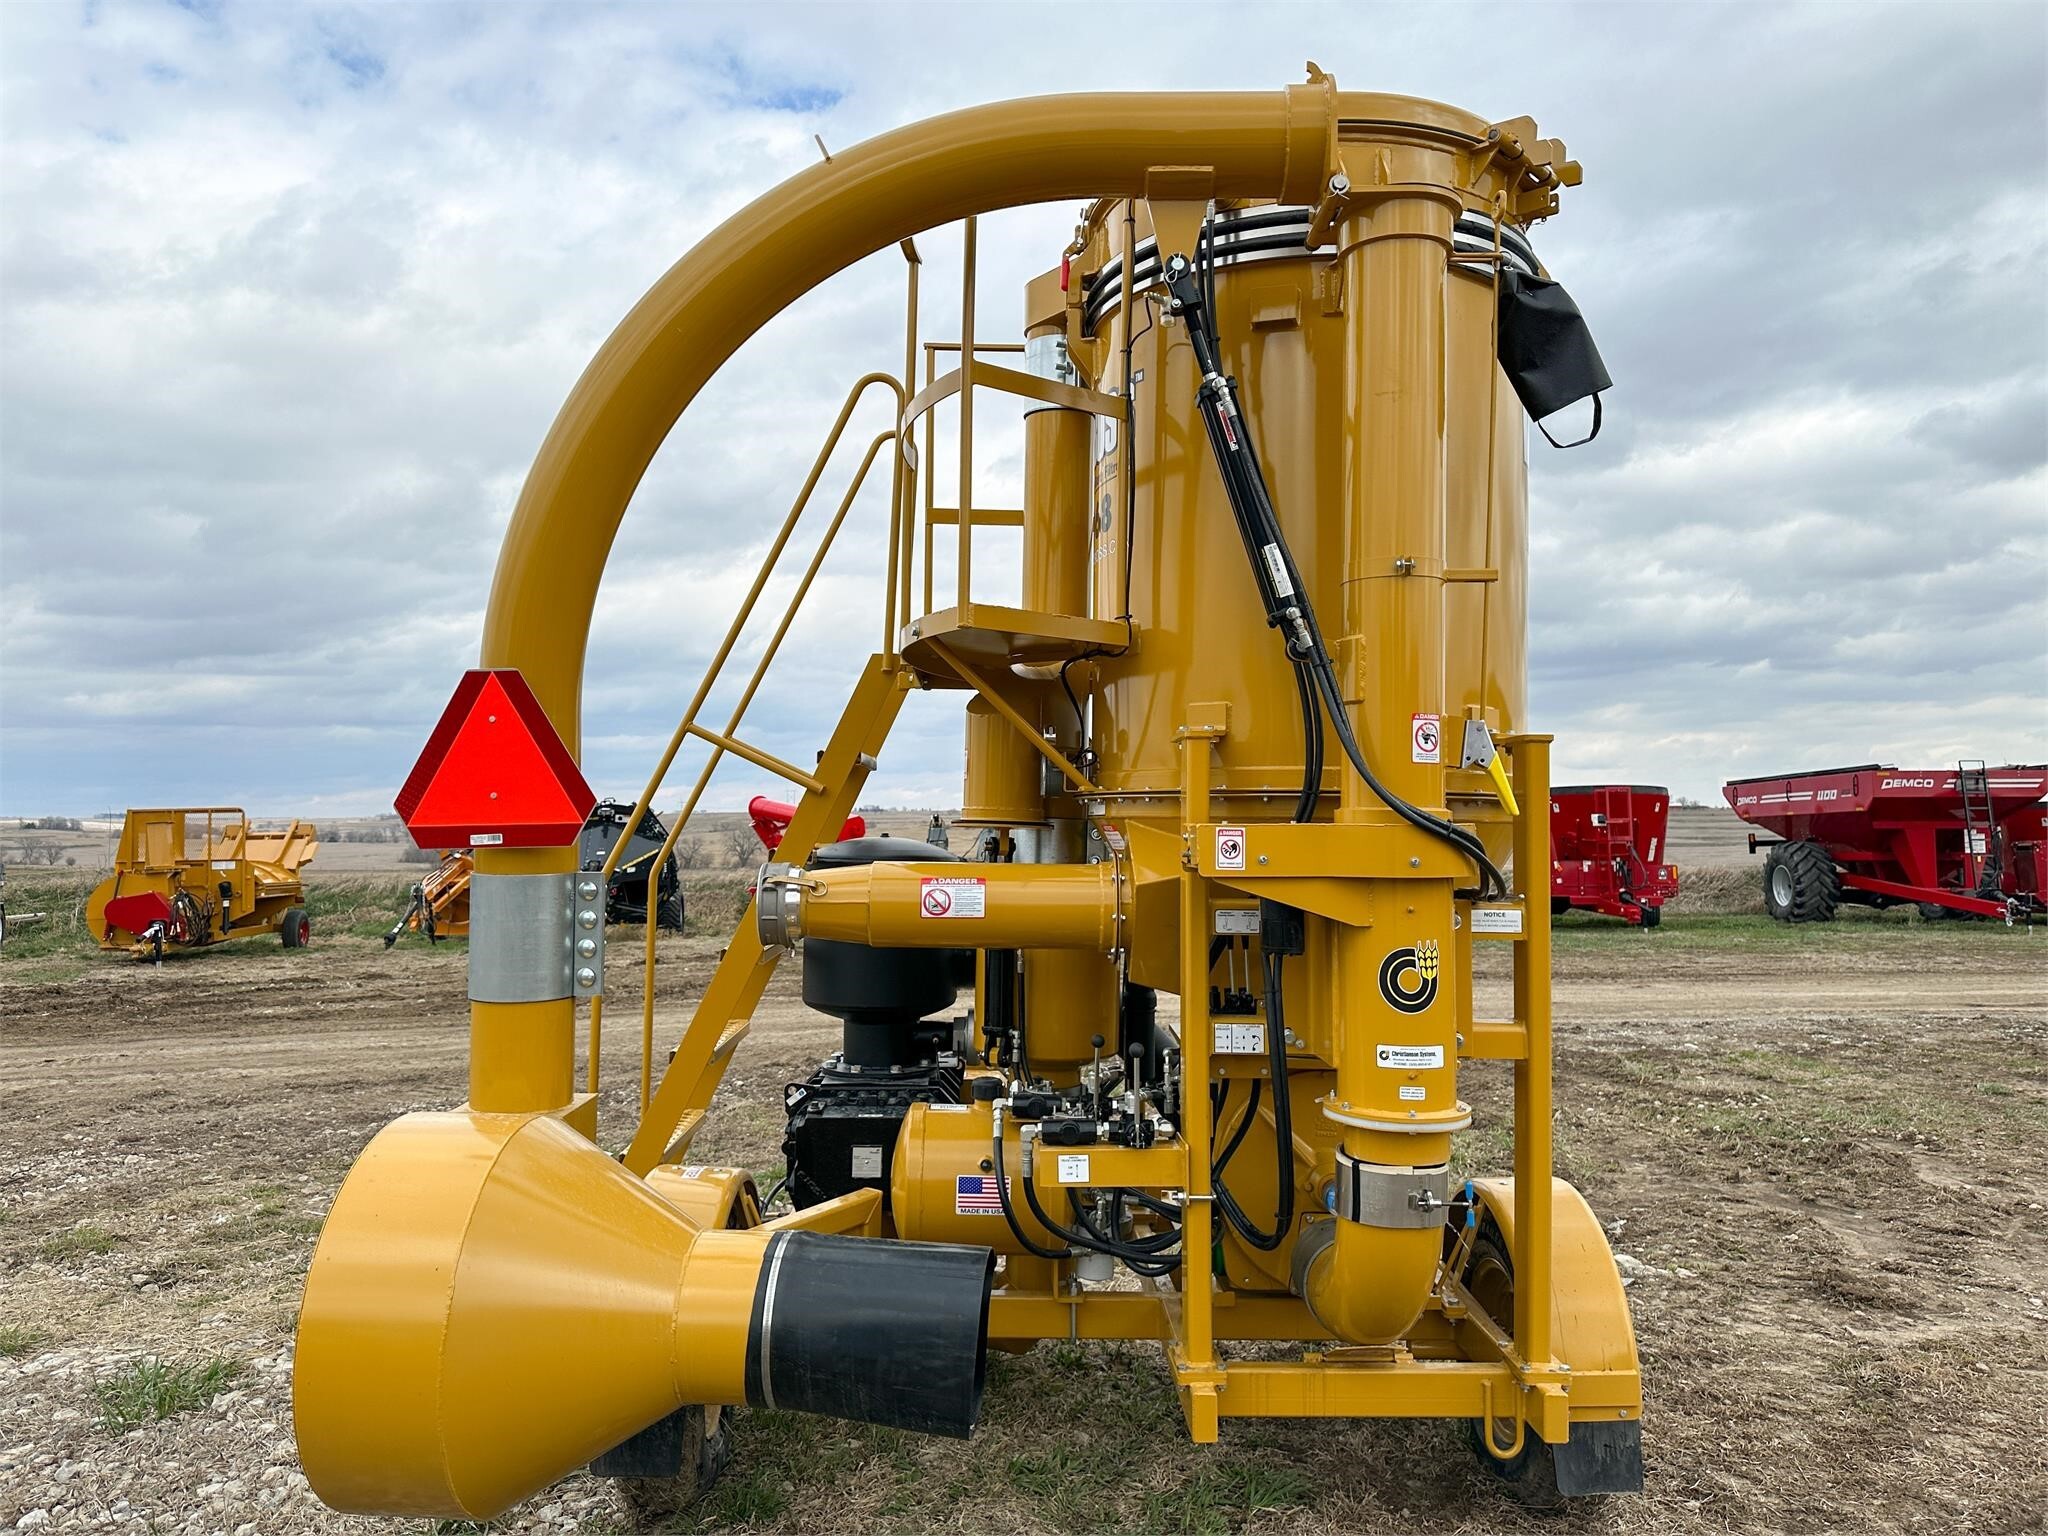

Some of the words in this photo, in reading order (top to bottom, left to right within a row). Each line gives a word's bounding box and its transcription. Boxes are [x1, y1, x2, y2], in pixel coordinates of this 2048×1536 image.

[1881, 779, 1934, 789] DEMCO
[1737, 796, 1757, 806] DEMCO
[1817, 789, 1837, 800] 1100
